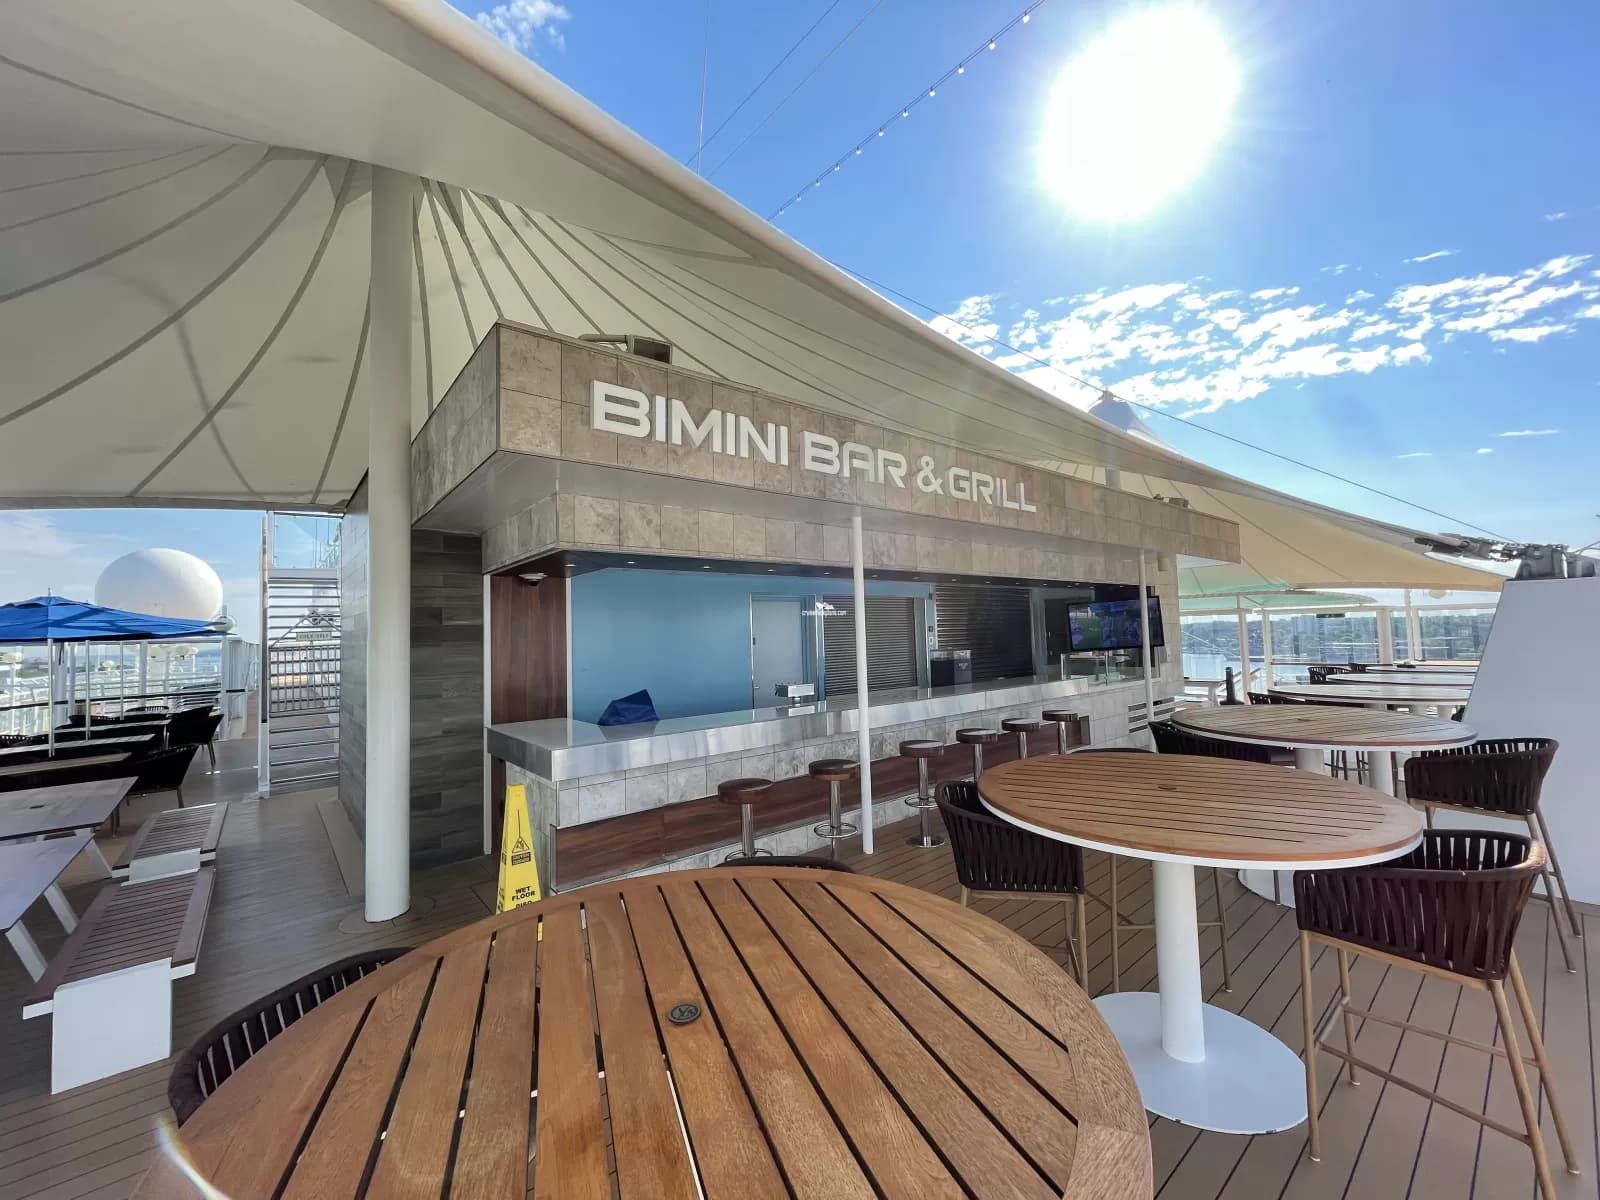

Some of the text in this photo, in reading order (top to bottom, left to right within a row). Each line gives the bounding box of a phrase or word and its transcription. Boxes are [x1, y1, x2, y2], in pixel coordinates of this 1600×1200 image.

[590, 380, 1037, 512] BIMINI BAR & GRILL
[515, 886, 530, 895] WET
[511, 891, 536, 902] FLOOR
